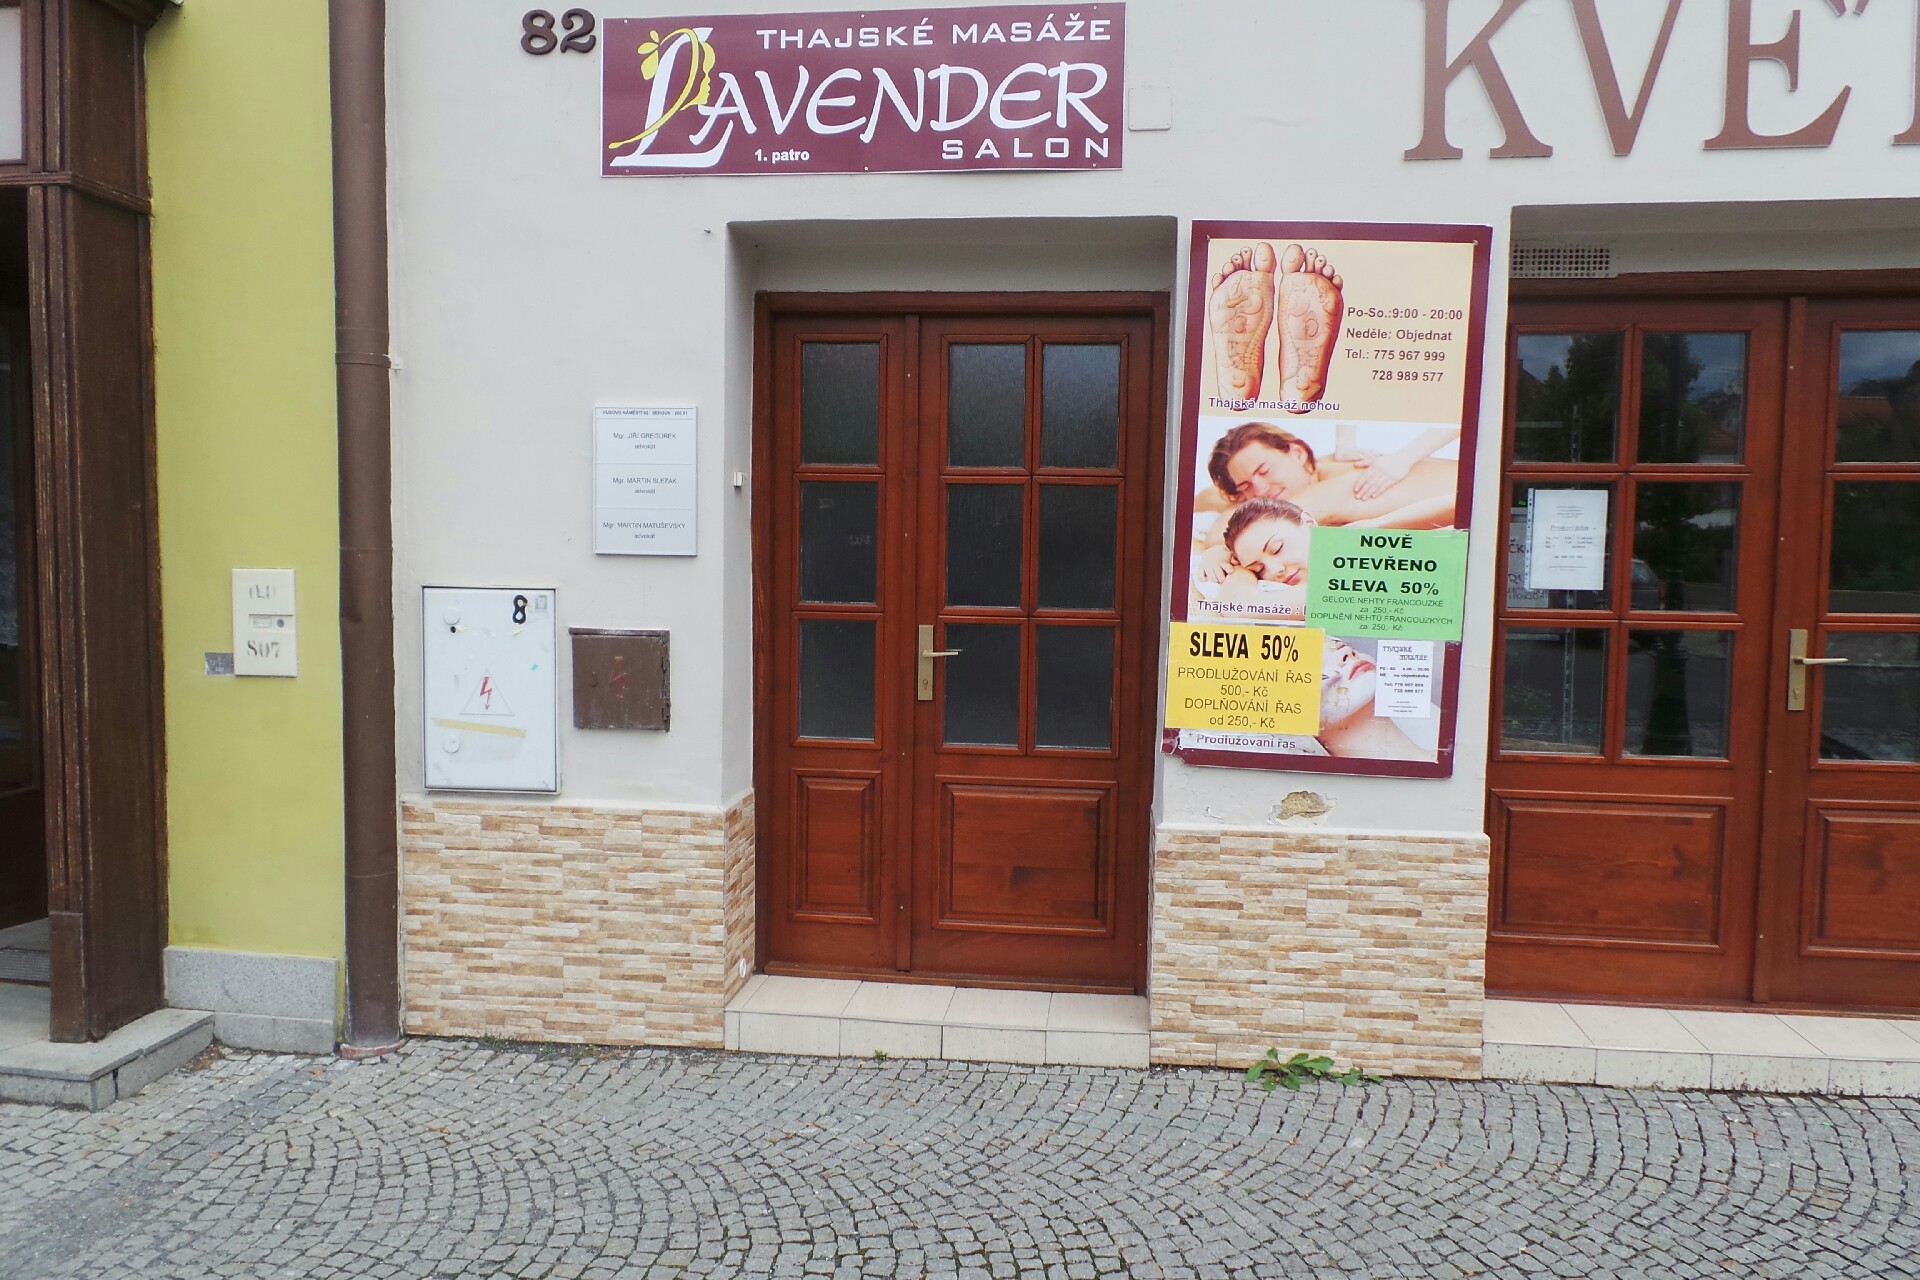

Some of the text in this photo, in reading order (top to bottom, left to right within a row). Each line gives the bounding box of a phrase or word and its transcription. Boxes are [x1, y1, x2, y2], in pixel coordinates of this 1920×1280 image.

[520, 9, 596, 55] 82
[756, 14, 1111, 49] THAJSKÉ MASÁŽE
[609, 27, 1109, 168] LAVENDER
[941, 137, 1110, 159] SALON
[755, 149, 810, 164] 1. patro
[1430, 309, 1463, 321] 20:00
[1346, 327, 1453, 343] Neděle: Objednat
[1345, 348, 1446, 362] Tel.: 775 967 999
[1372, 370, 1444, 382] 728 989 577
[1208, 397, 1341, 411] Thajská masáž nohou
[1360, 534, 1413, 549] NOVĚ
[1332, 556, 1437, 572] OTEVŘENO
[1328, 578, 1439, 595] SLEVA 50%
[512, 594, 528, 625] 8
[1197, 600, 1243, 613] Thajské
[1247, 603, 1292, 614] masáže
[1310, 612, 1352, 620] DOPLNĚNÍ
[1189, 631, 1299, 662] SLEVA 50%
[1177, 666, 1313, 683] PRODLUŽOVÁNÍ ŘAS
[1220, 684, 1269, 697] 500,- Kč
[1184, 697, 1303, 714] DOPLŇOVÁNÍ ŘAS
[1209, 715, 1276, 729] od 250,- Kč
[1277, 739, 1296, 749] řas
